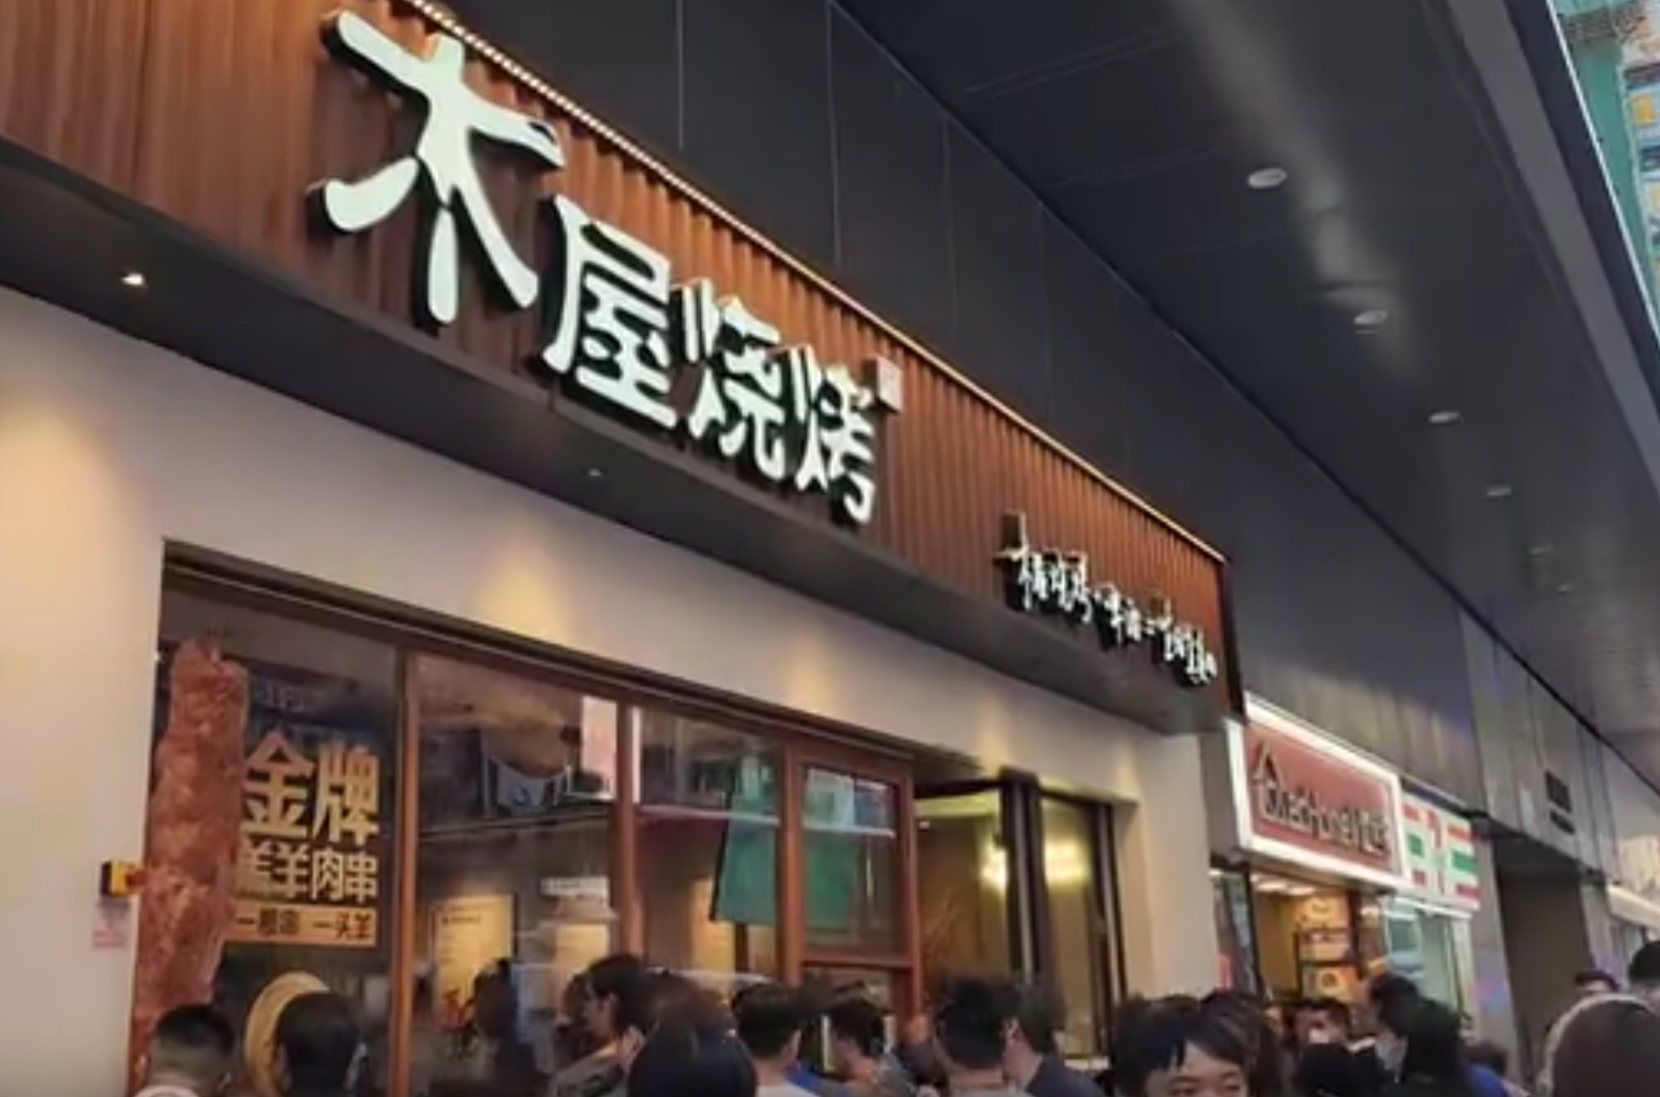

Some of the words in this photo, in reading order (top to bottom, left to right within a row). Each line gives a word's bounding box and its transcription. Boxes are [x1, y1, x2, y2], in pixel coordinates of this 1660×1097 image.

[322, 9, 879, 524] 木屋烧烤
[240, 731, 379, 846] 金牌
